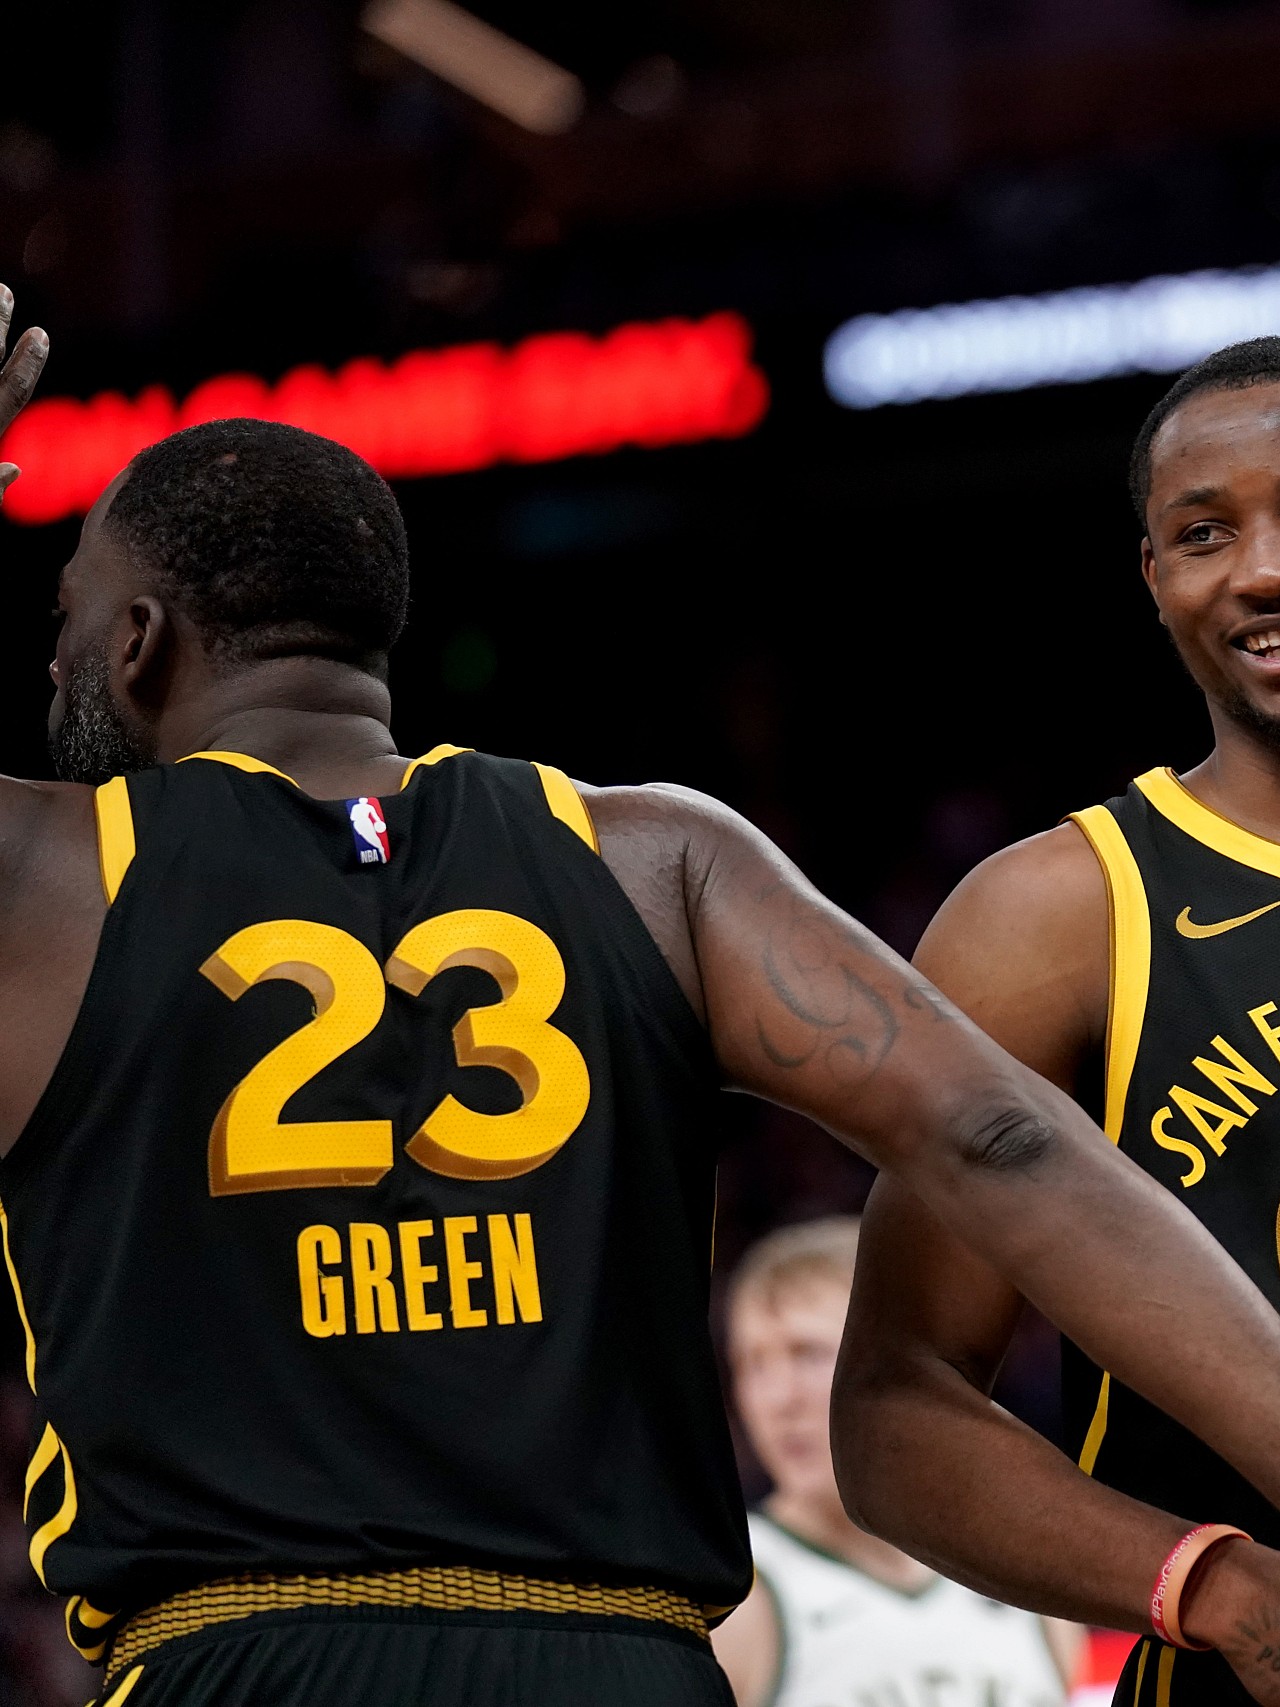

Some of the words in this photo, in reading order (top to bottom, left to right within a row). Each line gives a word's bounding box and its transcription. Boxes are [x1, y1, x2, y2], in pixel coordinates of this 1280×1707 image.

[360, 848, 380, 864] NBA
[198, 908, 591, 1198] 23
[1150, 1035, 1278, 1188] SAN
[296, 1212, 544, 1339] GREEN
